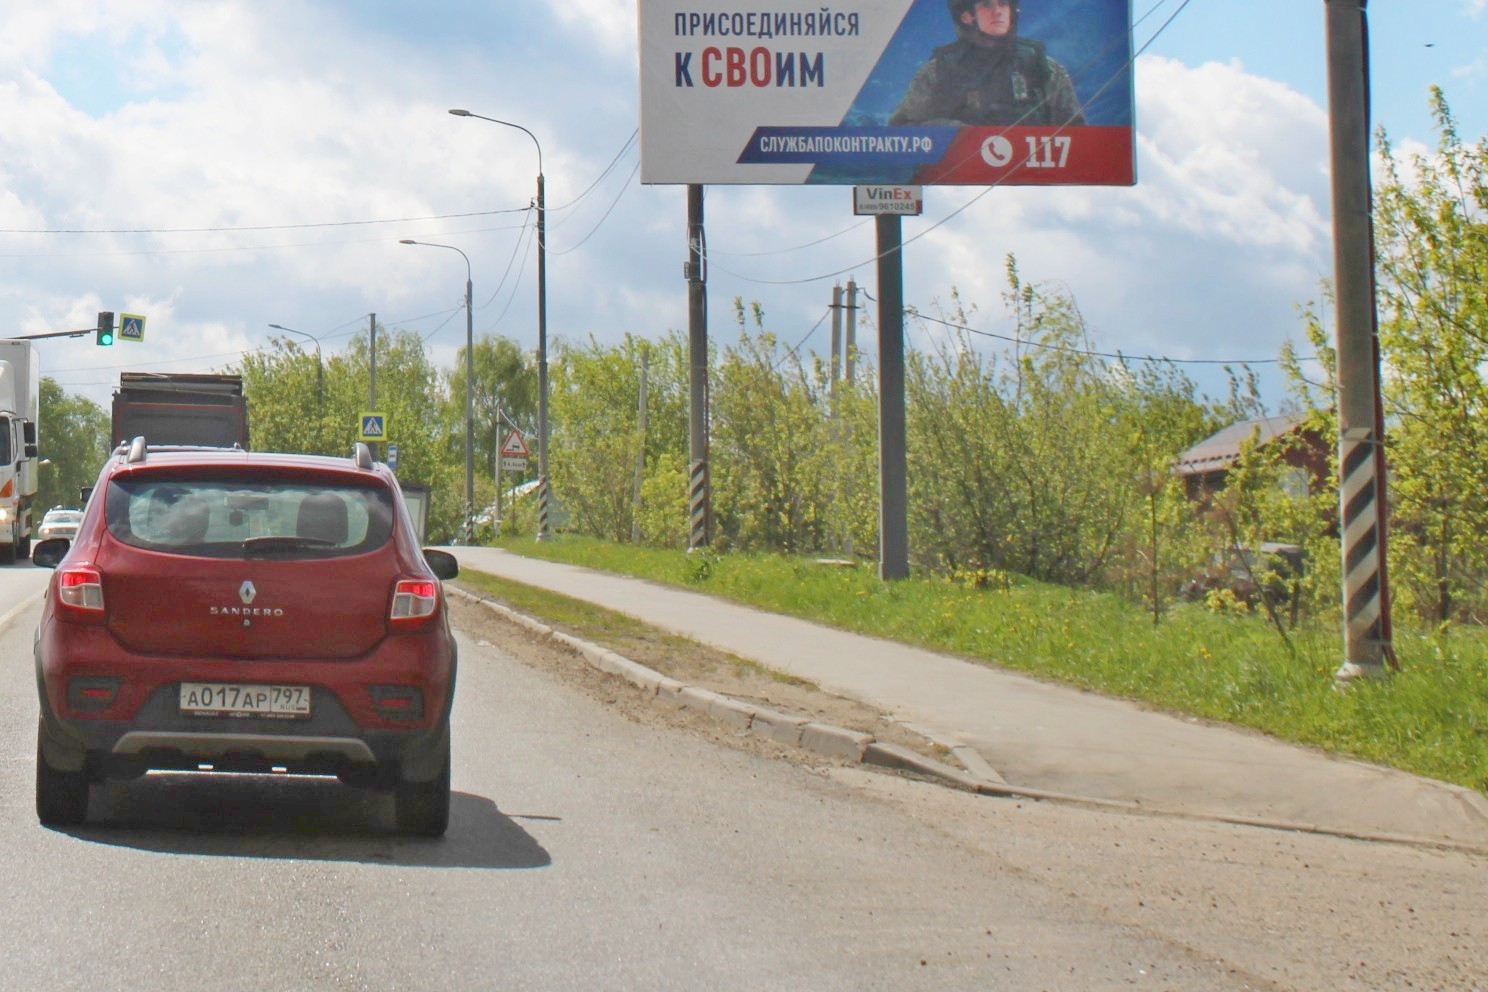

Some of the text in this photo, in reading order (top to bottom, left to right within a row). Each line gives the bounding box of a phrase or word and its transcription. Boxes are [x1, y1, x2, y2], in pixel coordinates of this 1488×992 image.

[674, 7, 860, 39] ПРИСОЕДИНЯЙСЯ
[674, 52, 694, 88] К
[759, 135, 933, 154] СЛУЖБАПОКОНТРАКТУ.РФ
[1024, 135, 1072, 169] 117
[866, 187, 912, 200] VinEx
[209, 606, 284, 617] SANDERO
